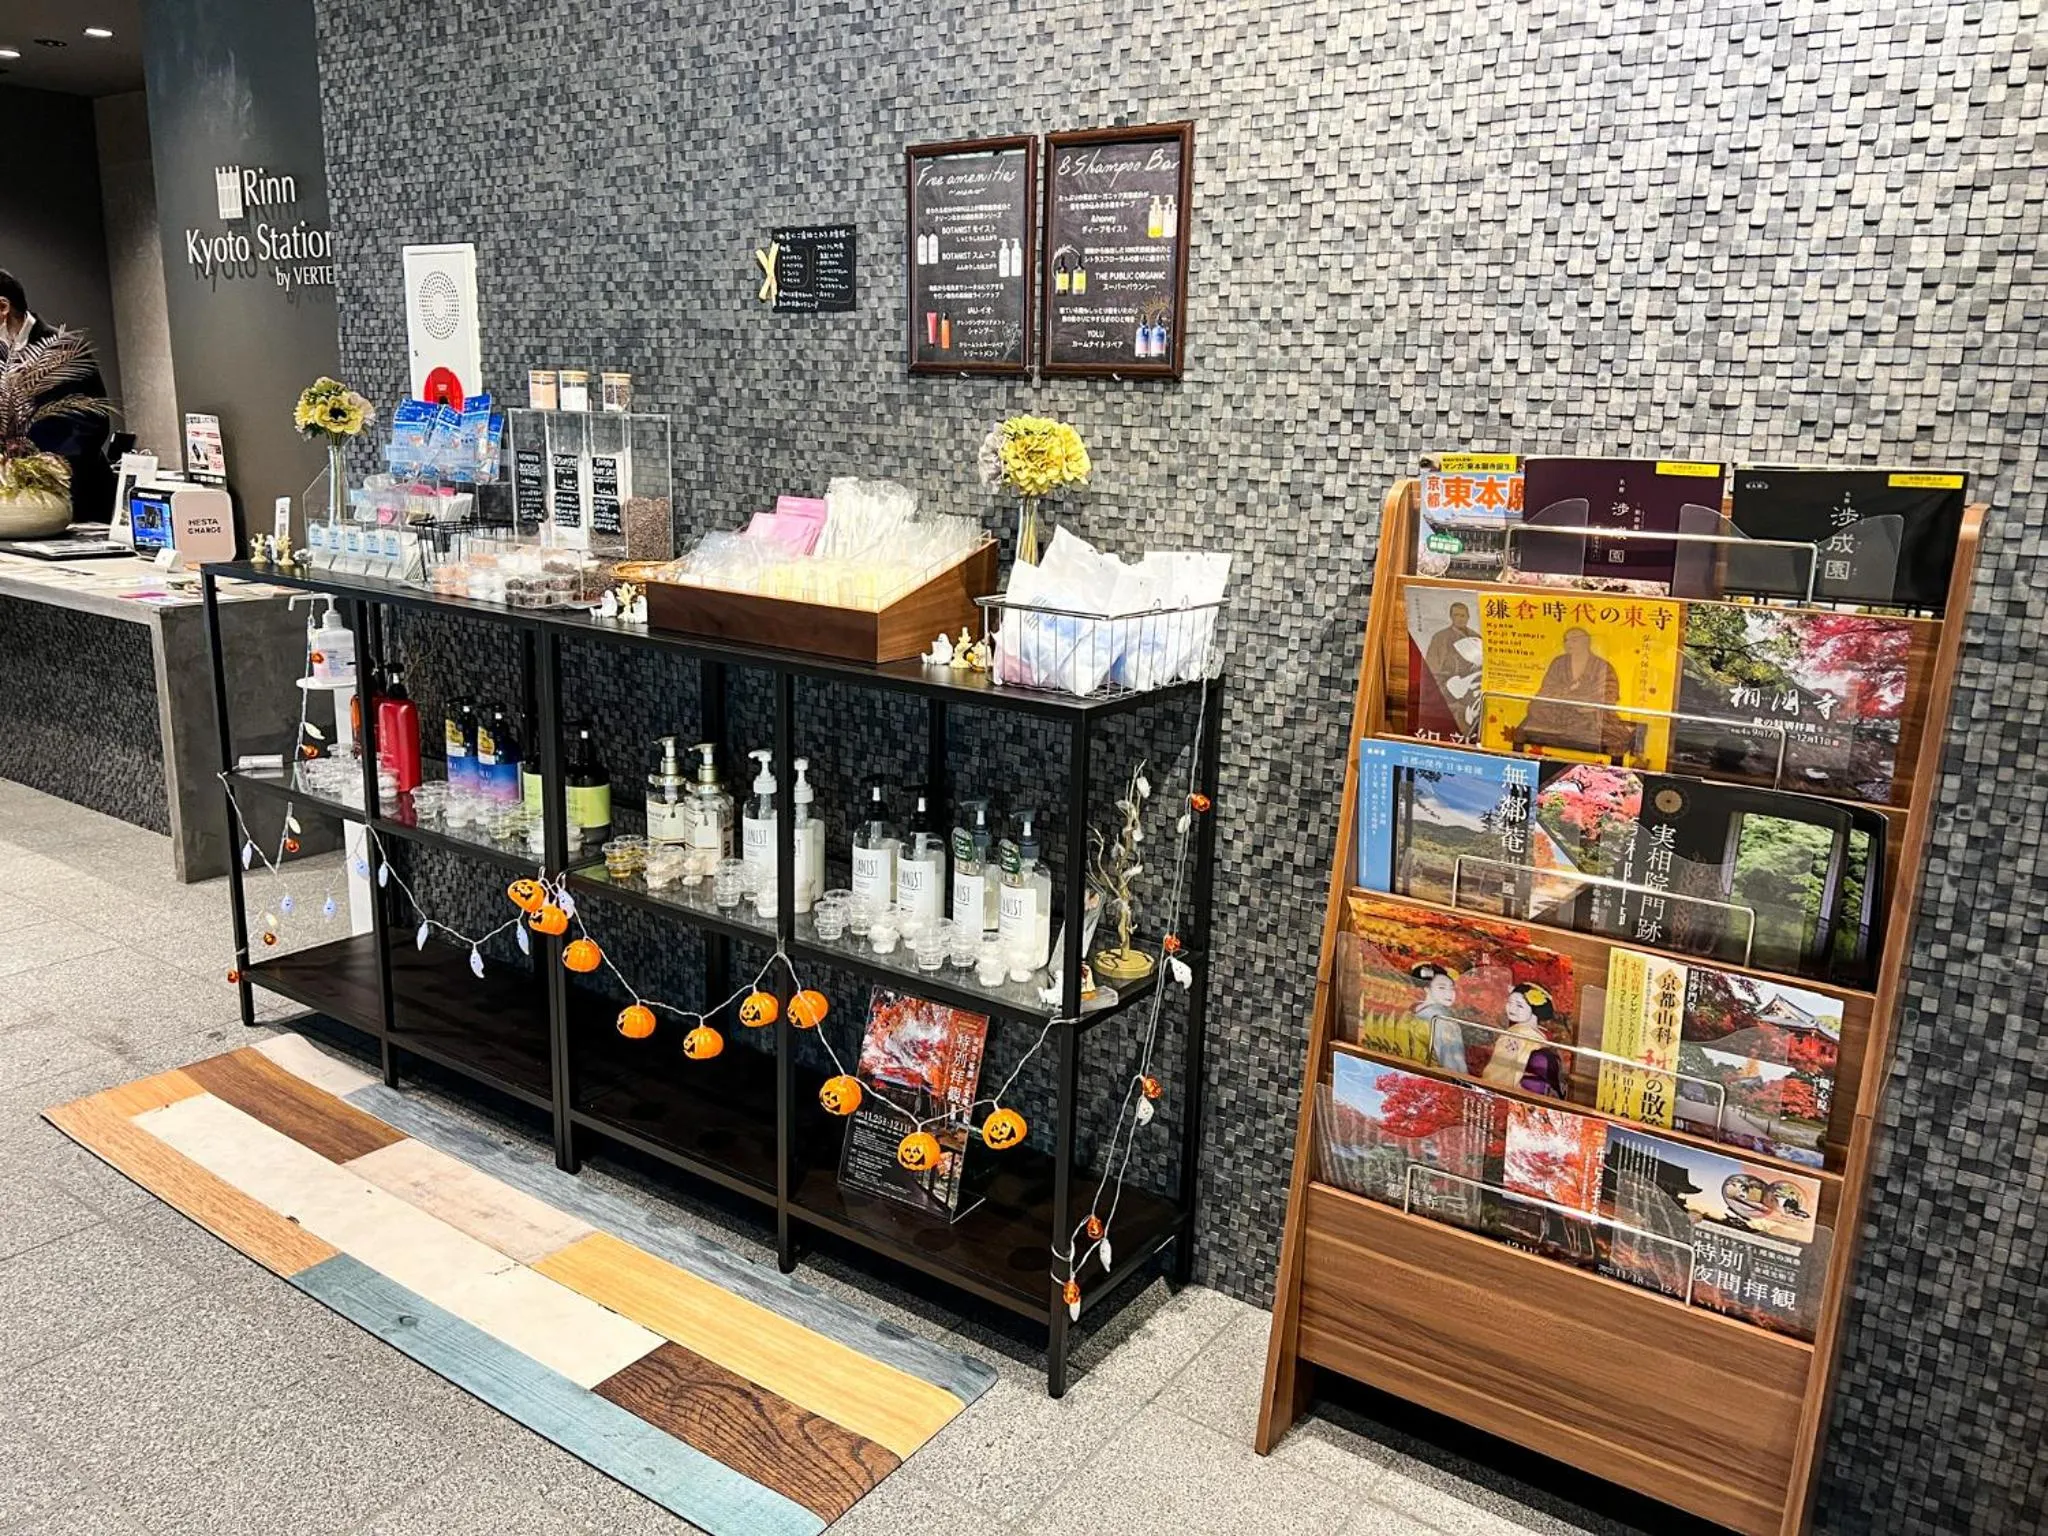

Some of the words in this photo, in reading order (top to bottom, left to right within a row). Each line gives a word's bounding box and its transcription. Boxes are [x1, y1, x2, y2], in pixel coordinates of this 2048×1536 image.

[917, 165, 943, 186] Free
[946, 158, 1017, 185] amenities
[1145, 148, 1180, 171] Bar
[243, 167, 296, 206] Rinn
[972, 225, 997, 233] モイスト
[1081, 225, 1129, 234] ディープモイスト
[186, 228, 250, 276] Kyoto
[972, 251, 997, 259] スムース
[275, 266, 290, 292] by
[1095, 271, 1108, 280] THE
[1109, 271, 1134, 280] PUBLIC
[1134, 271, 1166, 280] ORGANIC
[1427, 476, 1440, 508] 京都
[187, 526, 222, 535] CHARGE
[1608, 502, 1631, 563] 渉園
[1825, 506, 1860, 580] 渉成園
[1485, 599, 1675, 632] 鎌倉時代の東寺
[1512, 631, 1545, 640] Temple
[1635, 823, 1677, 943] 実相院門跡
[1656, 971, 1679, 1045] 京都山科
[1693, 1240, 1743, 1272] 特別
[1693, 1263, 1797, 1312] 夜間拝観
